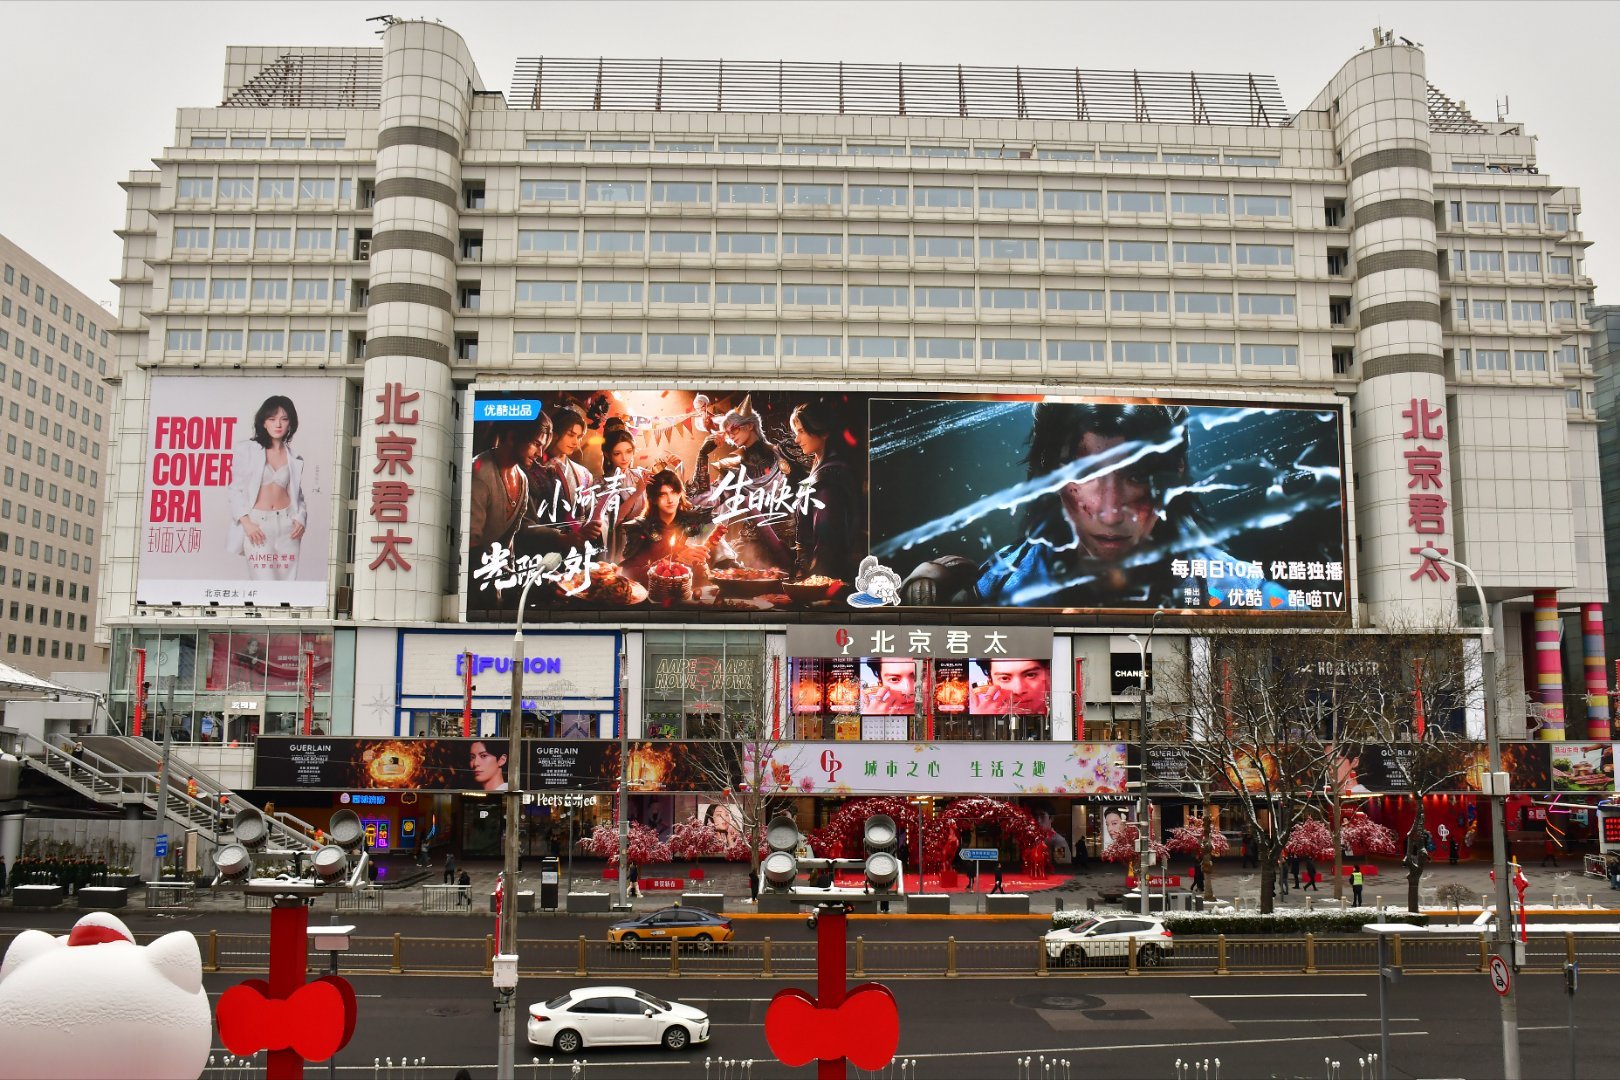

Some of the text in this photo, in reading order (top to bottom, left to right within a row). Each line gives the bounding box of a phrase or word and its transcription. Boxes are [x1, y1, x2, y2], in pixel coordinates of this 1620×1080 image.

[484, 404, 532, 416] 优酷出品
[154, 416, 237, 450] FRONT
[152, 453, 233, 487] COVER
[369, 382, 420, 571] 北京君太
[711, 464, 826, 521] 生日快乐
[1402, 398, 1450, 582] 北京君太
[149, 489, 202, 523] BRA
[148, 527, 202, 553] 封面文胸
[1171, 559, 1343, 580] 每周日10点 优酷独播
[205, 590, 239, 598] 北京君太
[1184, 588, 1200, 596] 播出
[1184, 597, 1200, 605] 平台
[1228, 588, 1342, 608] 优酷 酷喵TV
[871, 629, 1008, 654] 北京君太
[479, 657, 561, 673] FUION
[290, 744, 331, 752] GUERLAIN
[536, 747, 579, 755] GUERLAIN
[864, 760, 940, 777] 城市之心
[970, 760, 1046, 777] 生活之趣
